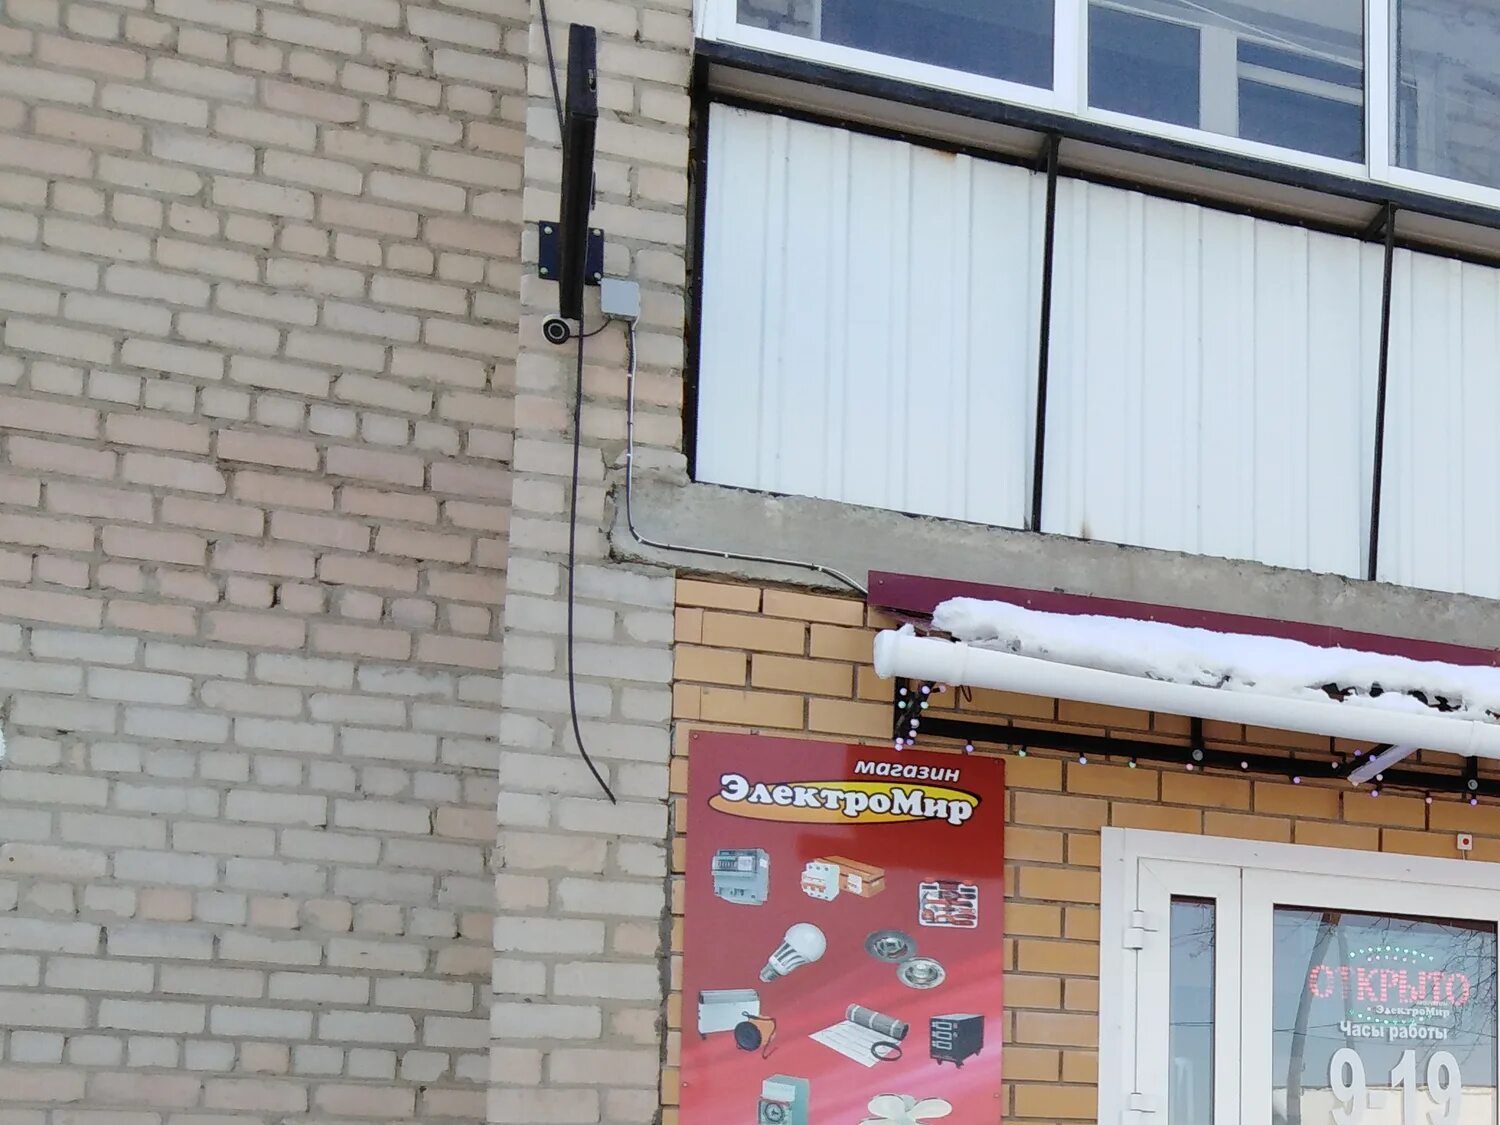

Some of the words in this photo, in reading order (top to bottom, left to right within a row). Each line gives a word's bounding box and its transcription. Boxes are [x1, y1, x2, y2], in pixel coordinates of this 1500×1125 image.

[854, 759, 960, 782] магазин
[720, 773, 974, 826] ЭлектроМир
[1308, 964, 1470, 1006] ОТКРЫТО
[1375, 1005, 1450, 1018] ЭлектроМир
[1339, 1020, 1384, 1038] Часы
[1389, 1022, 1448, 1041] работы
